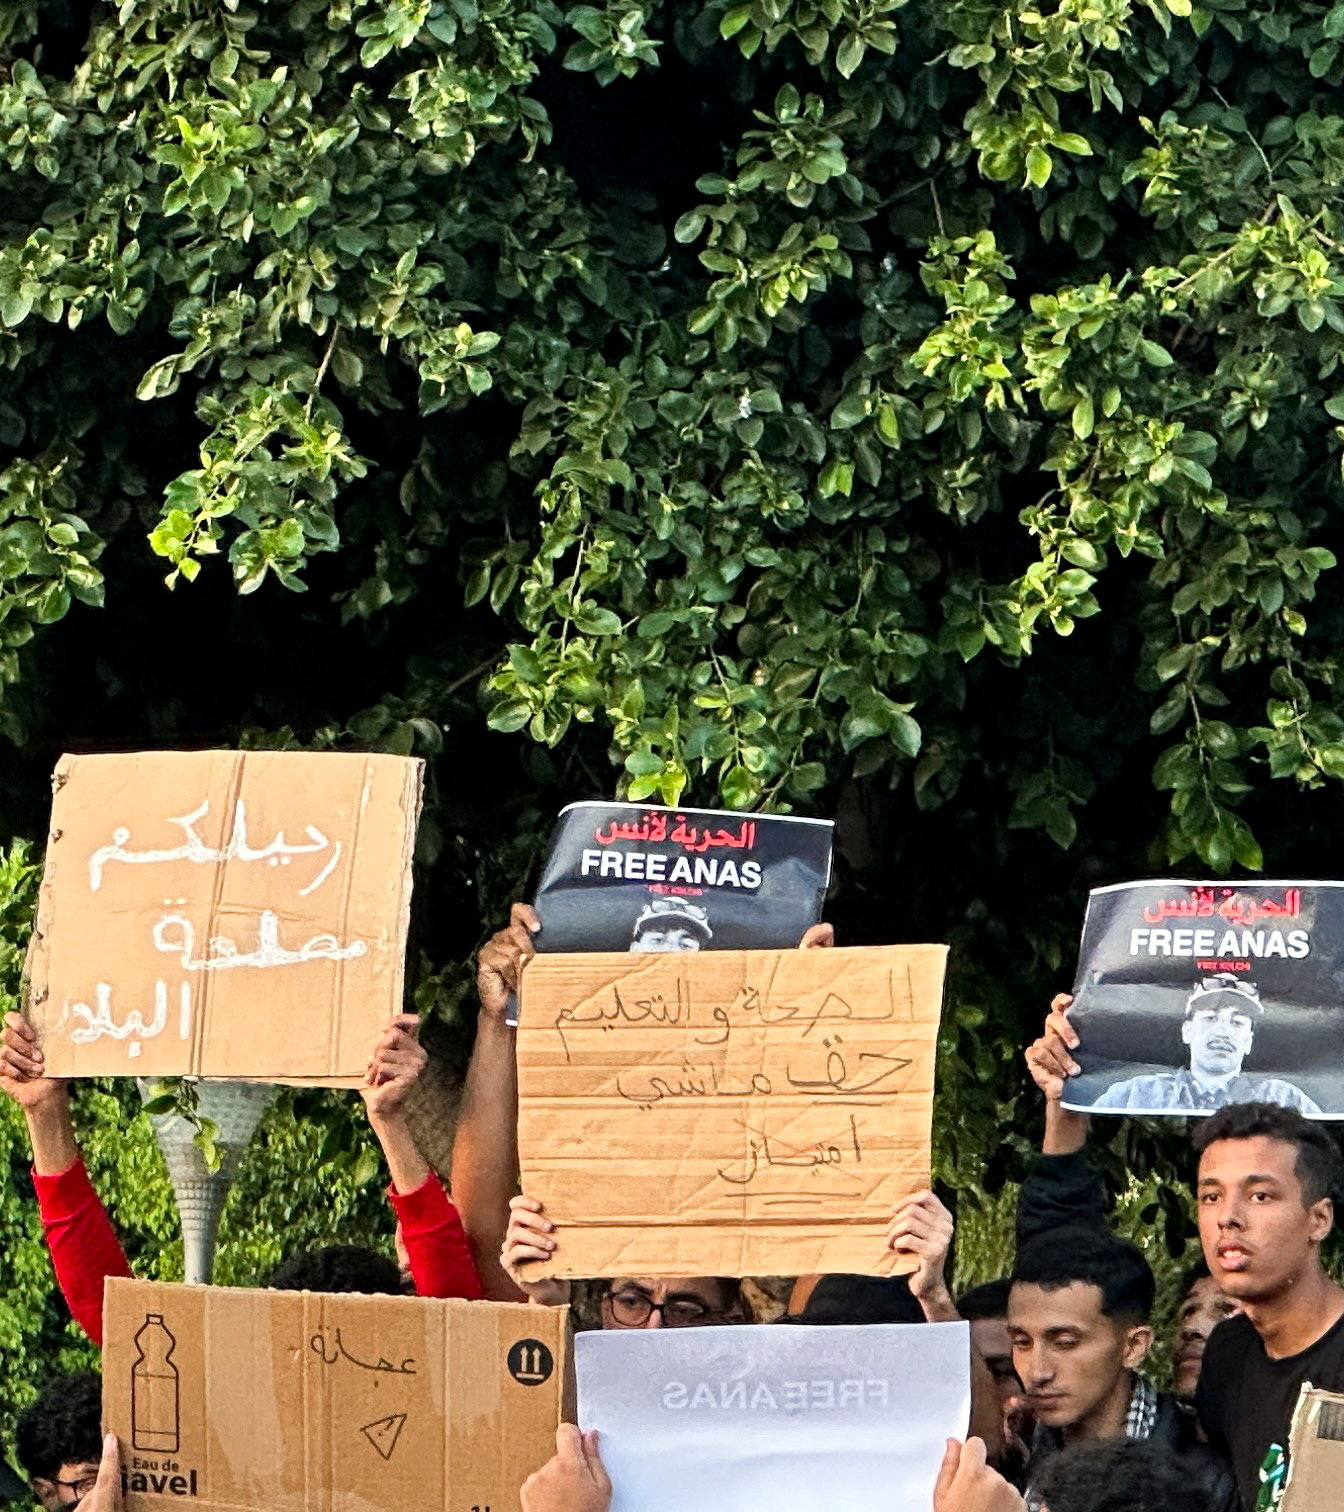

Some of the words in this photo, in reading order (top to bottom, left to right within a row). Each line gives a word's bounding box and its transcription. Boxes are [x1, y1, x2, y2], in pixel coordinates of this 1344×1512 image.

[89, 799, 343, 897] رحيلكم
[670, 813, 756, 852] الحرية
[581, 849, 665, 882] FREE
[674, 857, 763, 889] ANAS
[1218, 888, 1301, 925] الحرية
[1129, 928, 1216, 957] FREE
[1217, 929, 1310, 959] ANAS
[133, 1457, 159, 1471] Eau
[162, 1459, 180, 1473] de
